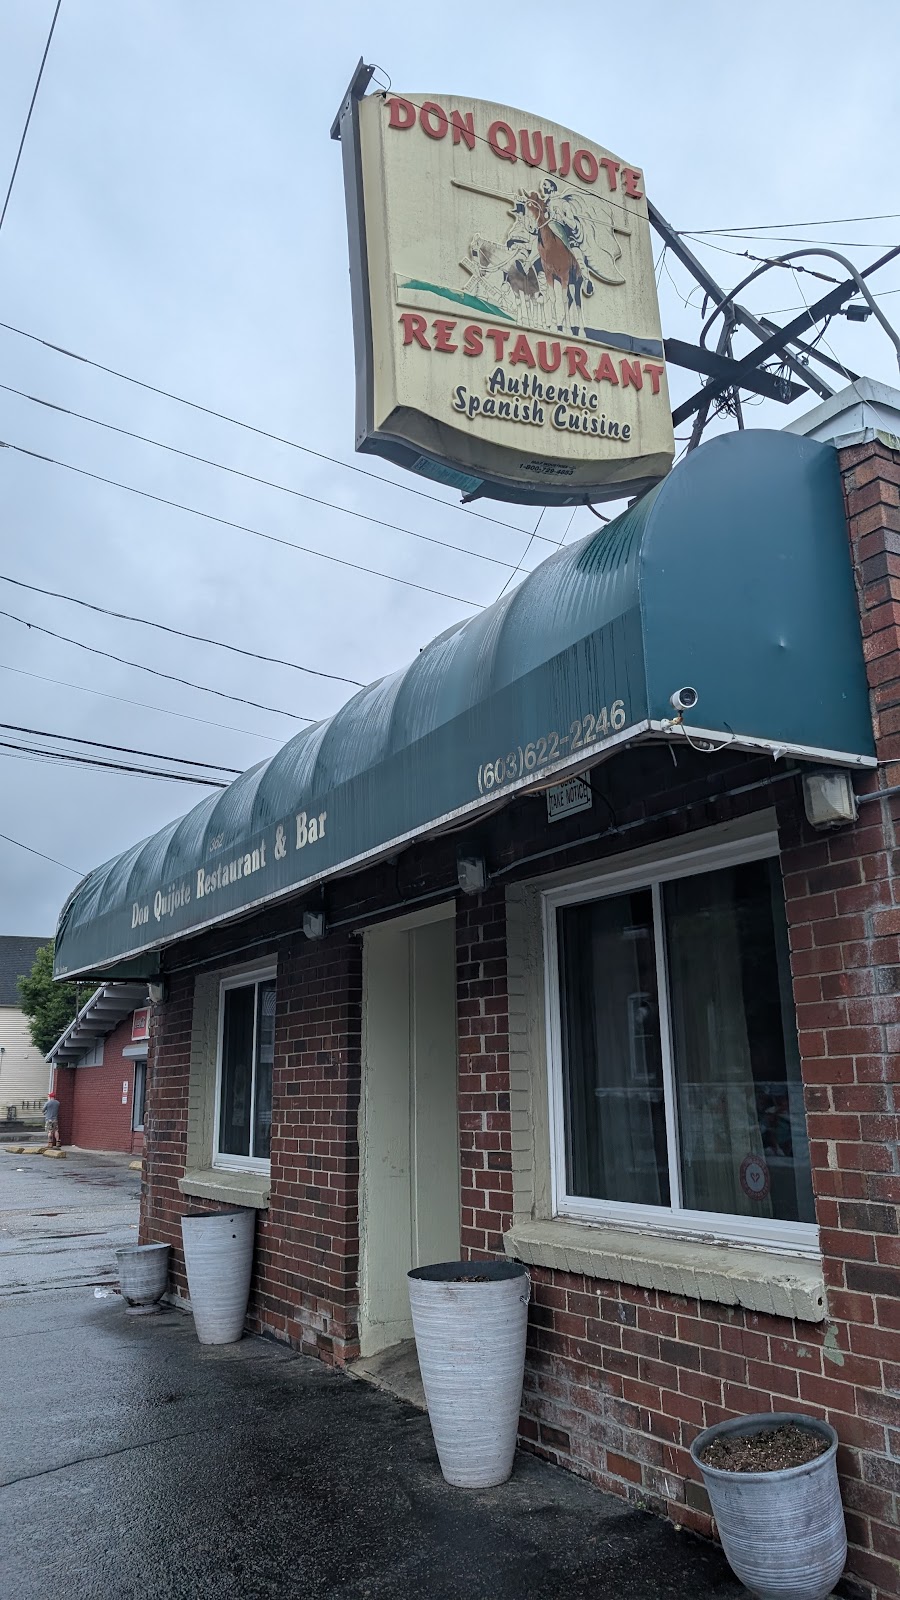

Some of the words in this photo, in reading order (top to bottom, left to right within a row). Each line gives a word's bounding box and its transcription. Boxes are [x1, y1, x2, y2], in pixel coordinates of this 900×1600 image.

[385, 97, 475, 150] DON
[487, 120, 644, 199] QUIJOTE
[400, 312, 664, 395] RESTAURANT
[488, 367, 598, 410] Authentic
[454, 385, 545, 424] Spanish
[551, 401, 632, 441] Cuisine
[477, 699, 626, 795] (603)622-2246
[131, 902, 149, 929] Don
[153, 881, 191, 922] Quijote
[196, 839, 266, 899] Restaurant
[273, 824, 287, 861] &
[295, 811, 327, 850] Bar
